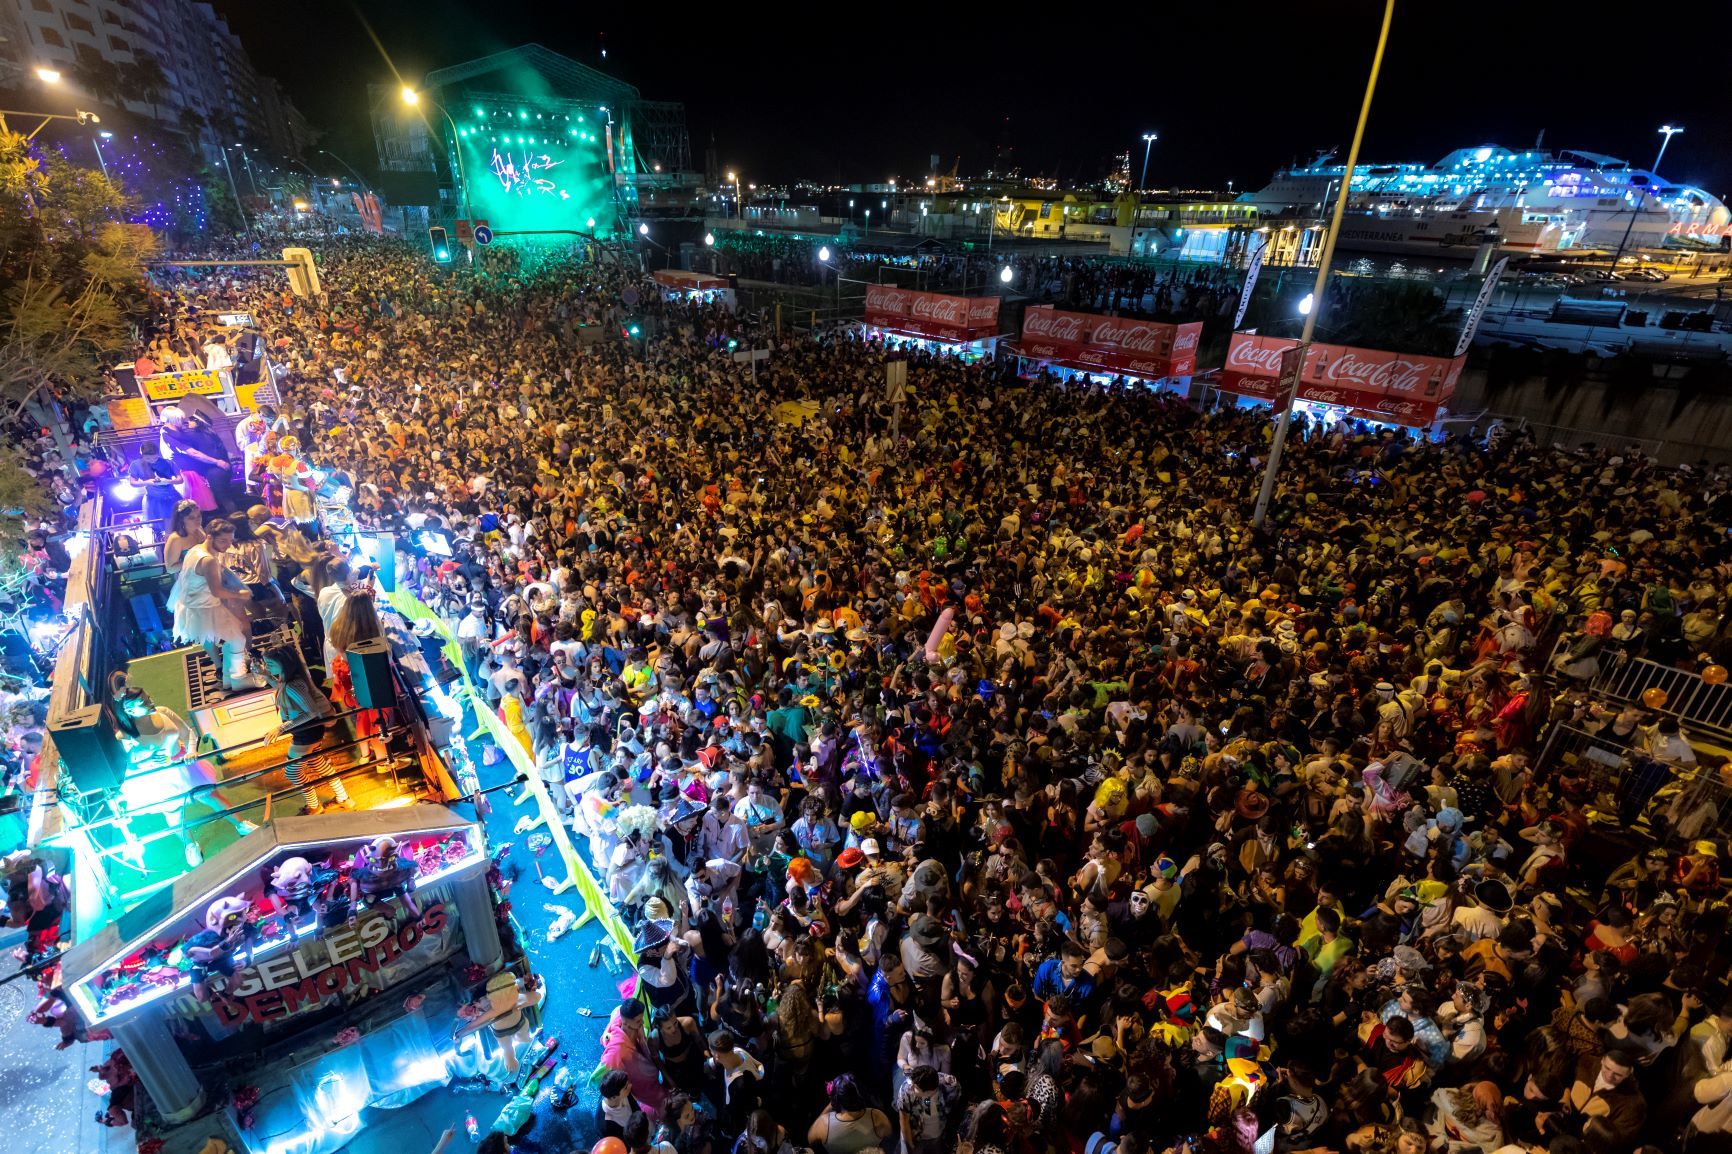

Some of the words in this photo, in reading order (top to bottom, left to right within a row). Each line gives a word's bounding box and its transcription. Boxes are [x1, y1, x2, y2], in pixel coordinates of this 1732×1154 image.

[911, 297, 961, 321] Coca-Cola
[1023, 313, 1084, 341] Coca-Cola
[1092, 322, 1162, 352] Coca-Cola
[155, 379, 214, 393] MEXICO
[1328, 354, 1429, 392] Coca-Cola
[211, 904, 449, 1026] DEMONIOS
